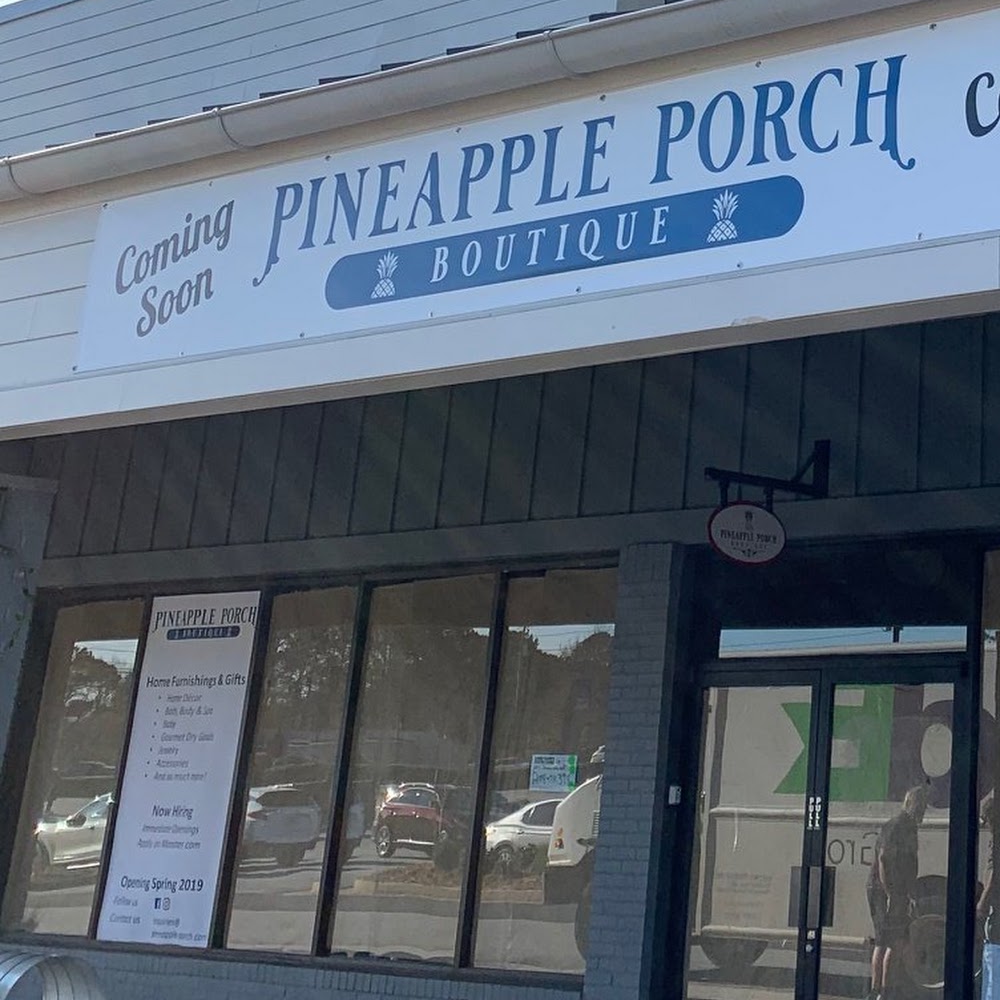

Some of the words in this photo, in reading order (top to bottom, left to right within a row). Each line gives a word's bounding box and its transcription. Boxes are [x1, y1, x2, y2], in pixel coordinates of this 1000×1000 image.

[252, 114, 616, 287] PINEAPPLE
[649, 54, 916, 186] PORCH
[115, 199, 235, 295] Coming
[429, 205, 670, 285] BOUTIQUE
[136, 267, 214, 338] Soon
[151, 609, 217, 633] PINEAPPLE
[220, 606, 258, 626] PORCH
[146, 676, 170, 688] Home
[171, 674, 216, 689] Furnishings
[218, 674, 223, 686] &
[225, 673, 246, 687] Gifts
[152, 805, 171, 818] Now
[173, 805, 193, 820] Hiring
[121, 876, 150, 891] Opening
[151, 877, 177, 893] Spring
[179, 879, 204, 892] 2019
